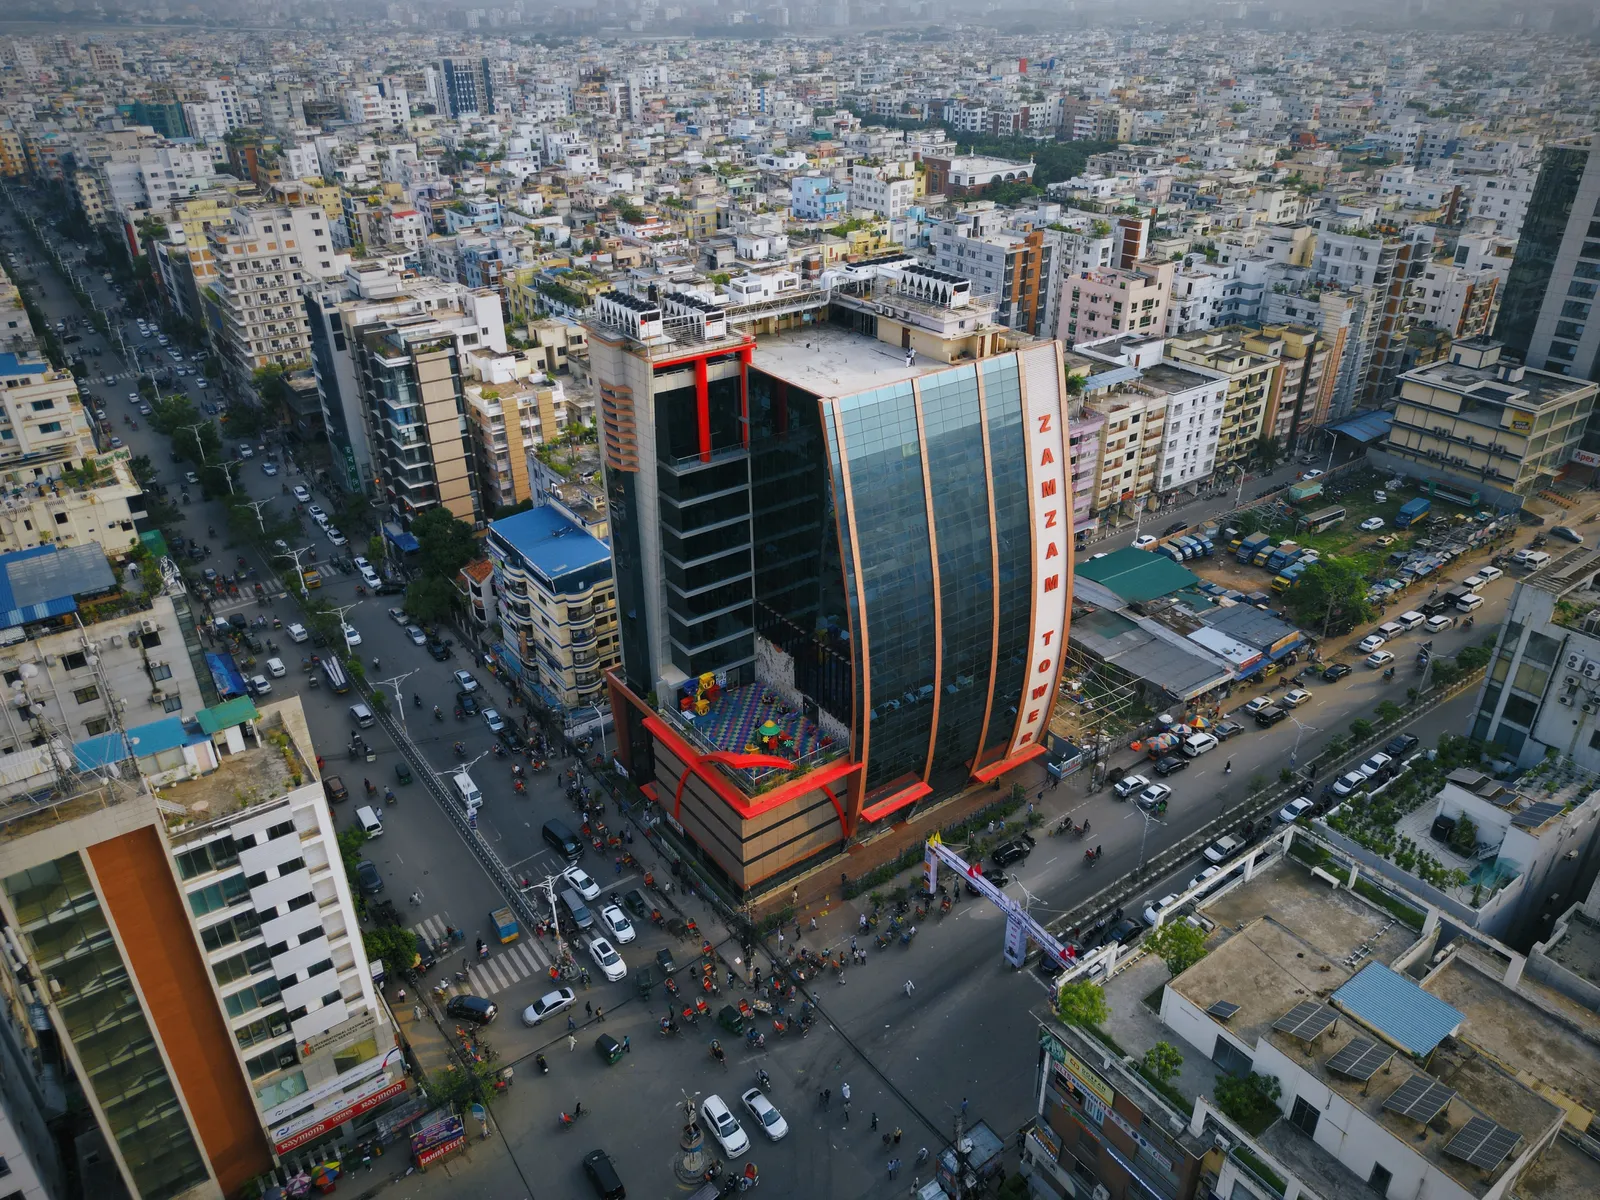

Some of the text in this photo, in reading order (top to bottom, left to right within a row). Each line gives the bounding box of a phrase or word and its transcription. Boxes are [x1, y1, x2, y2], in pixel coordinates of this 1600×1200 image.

[1576, 451, 1595, 463] Apex
[1020, 413, 1059, 745] ZAMZAM TOWER
[361, 1083, 403, 1109] Raymond
[1053, 1062, 1072, 1081] IELTS
[1075, 1081, 1099, 1105] SPOKEN
[281, 1124, 325, 1150] Raymond
[421, 1147, 445, 1165] RAHIM
[444, 1136, 464, 1152] STEE
